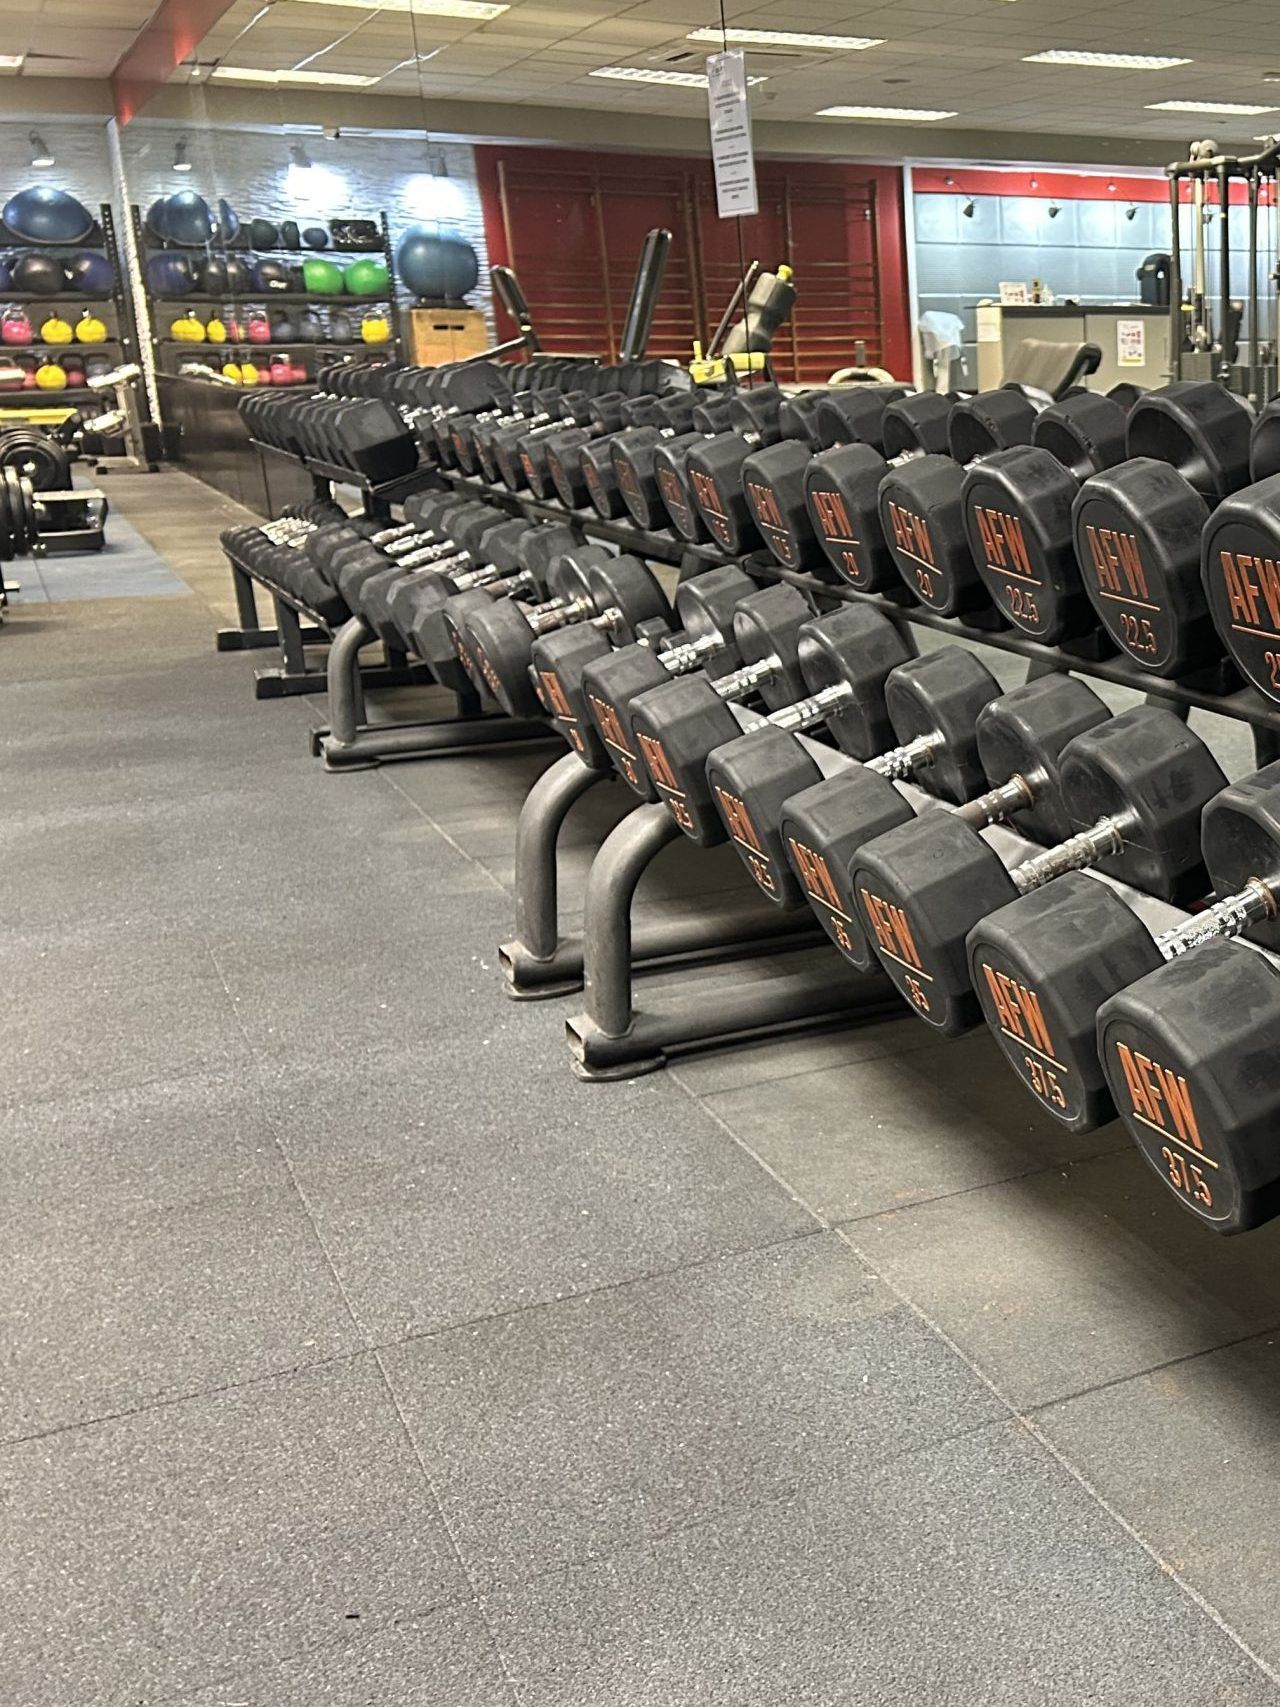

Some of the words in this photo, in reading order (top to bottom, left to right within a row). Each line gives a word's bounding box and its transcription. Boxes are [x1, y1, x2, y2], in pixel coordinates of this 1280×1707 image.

[812, 491, 854, 538] AFW
[889, 500, 935, 565] AFW
[974, 505, 1032, 575] AFW
[842, 551, 860, 576] 20
[915, 568, 934, 598] 20
[1086, 525, 1149, 600] AFW
[1005, 585, 1040, 624] 22.5
[1120, 613, 1159, 655] 22.5
[715, 785, 762, 851] AFW
[788, 837, 844, 911] AFW
[860, 887, 923, 969] AFW
[982, 963, 1056, 1059] AFW
[1024, 1056, 1068, 1110] 37.5
[1117, 1041, 1204, 1152] AFW
[1161, 1145, 1213, 1209] 37.5
